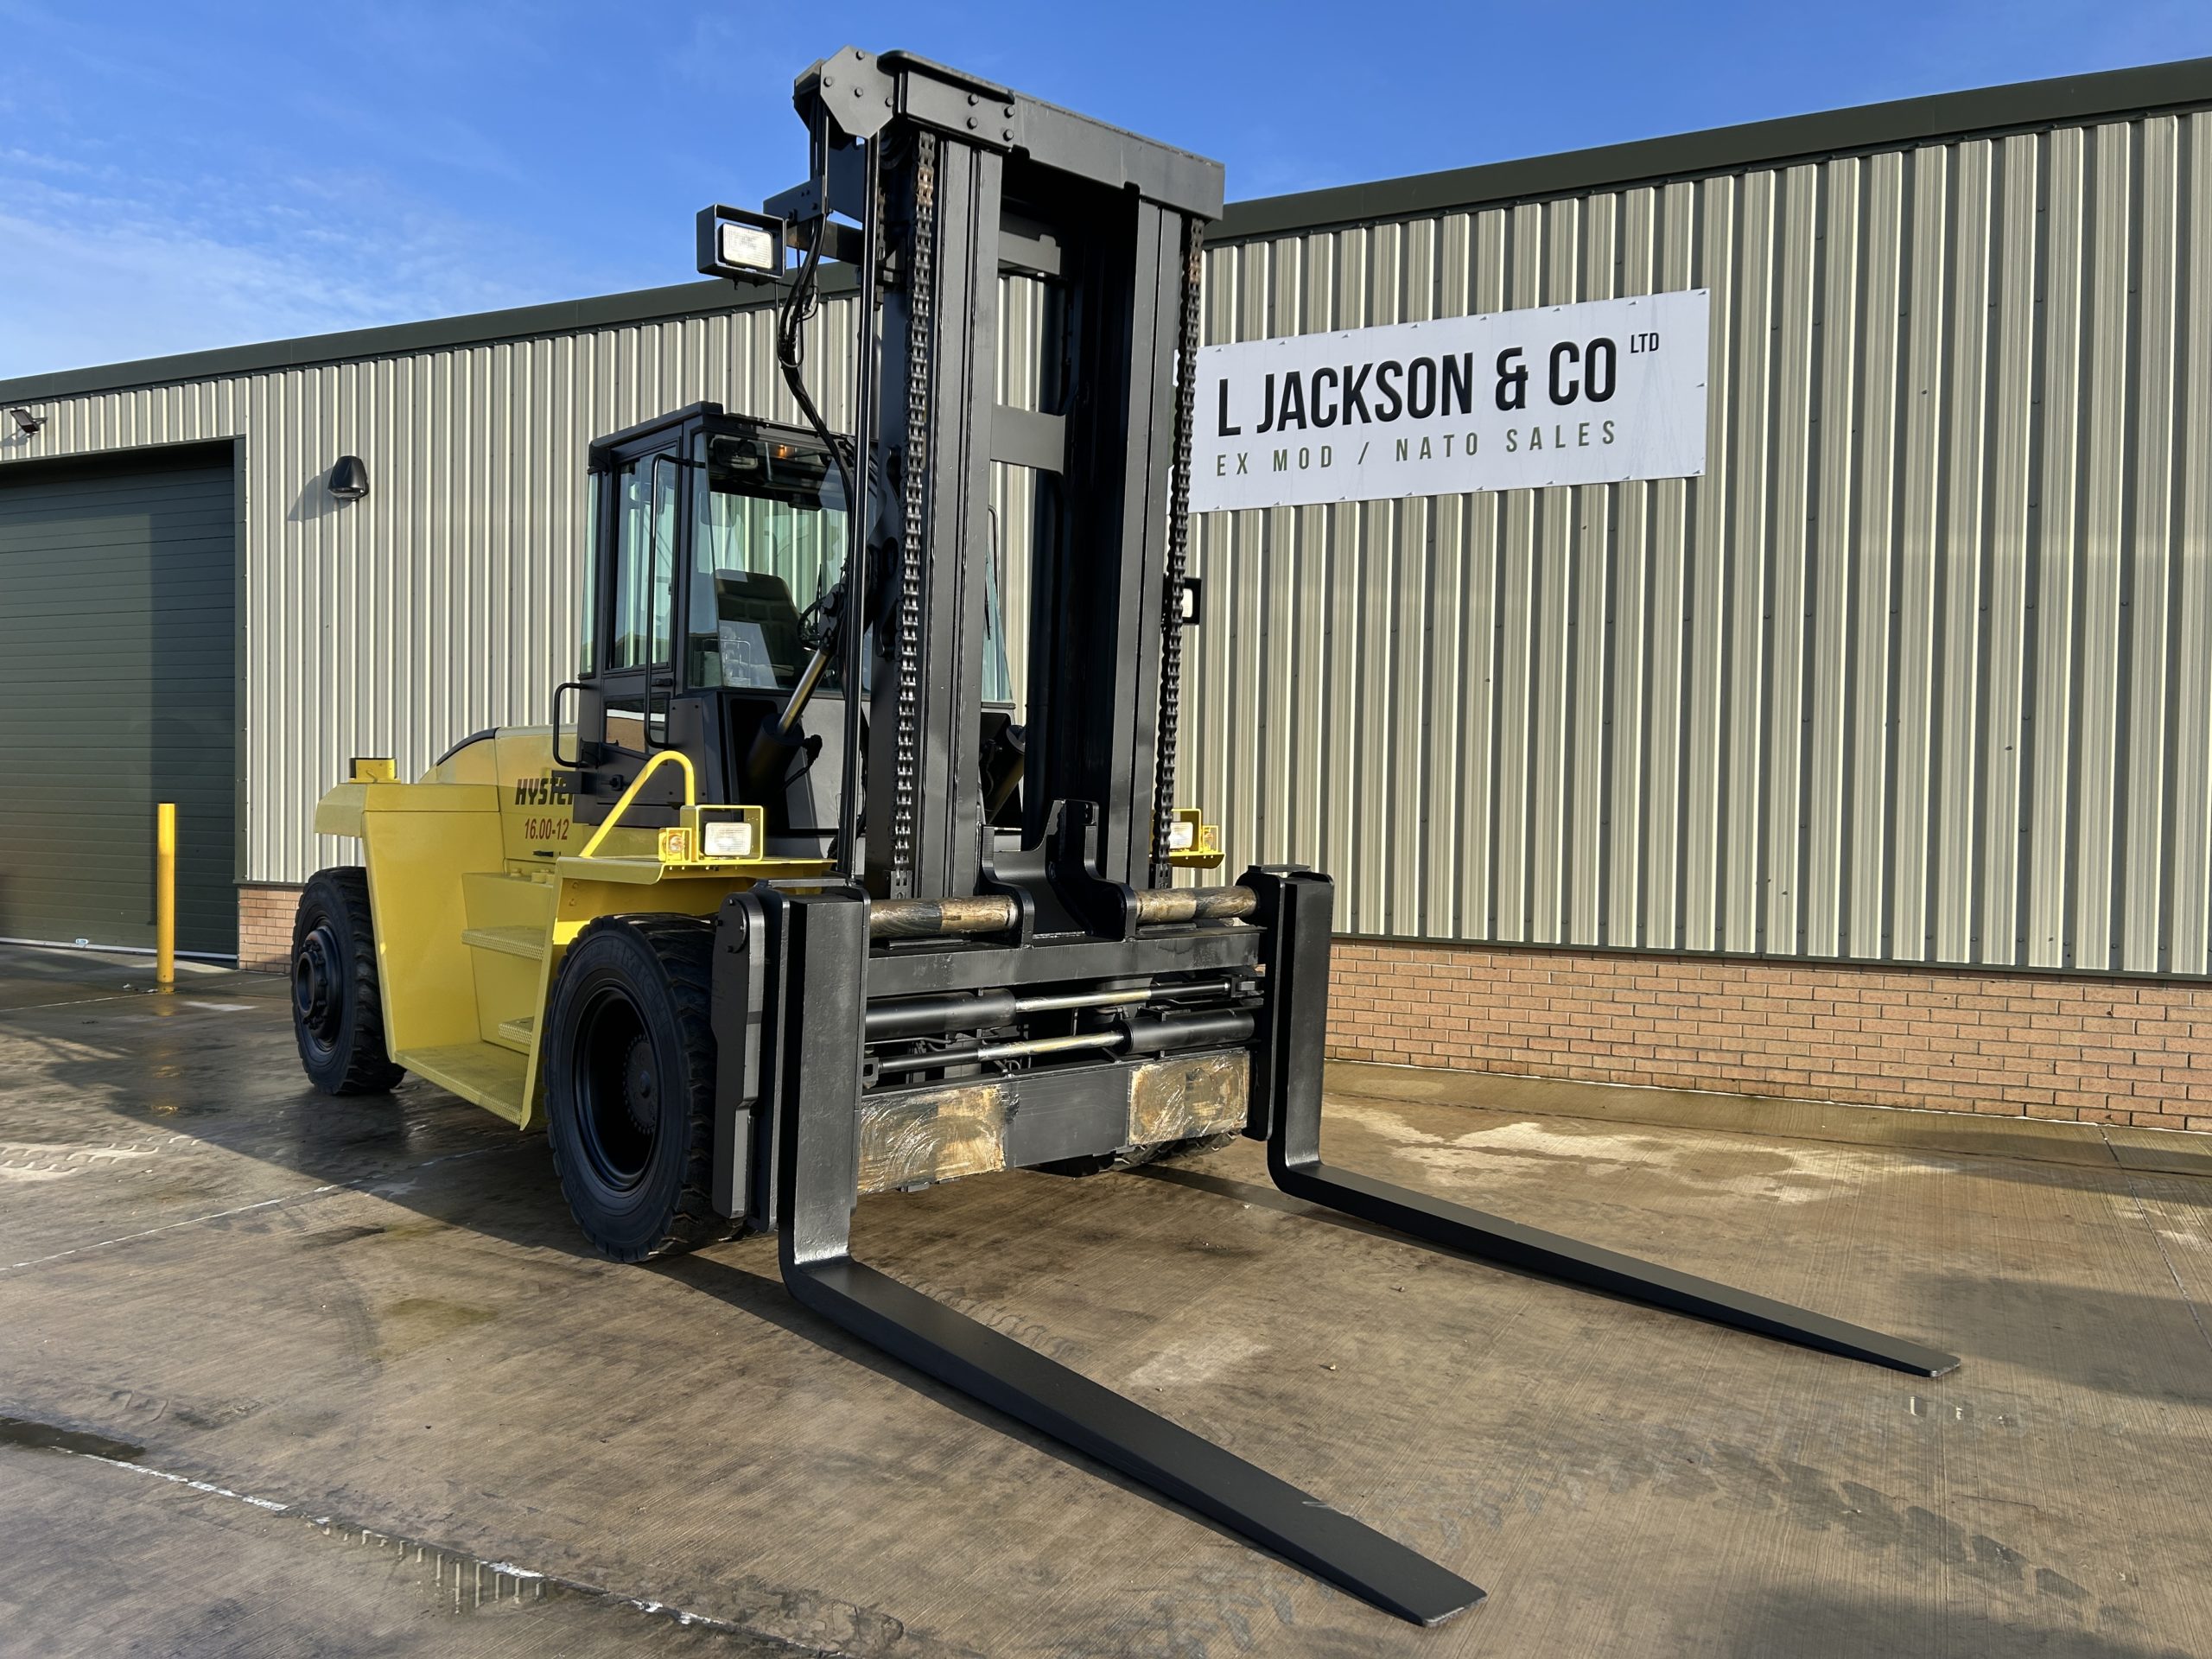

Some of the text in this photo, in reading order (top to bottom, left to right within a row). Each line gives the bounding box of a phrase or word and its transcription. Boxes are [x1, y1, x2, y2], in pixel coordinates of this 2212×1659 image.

[1218, 332, 1660, 437] L JACKSON & CO LTD
[1217, 420, 1615, 477] EX MOD / NATO SALES
[524, 817, 570, 841] 16.00-12
